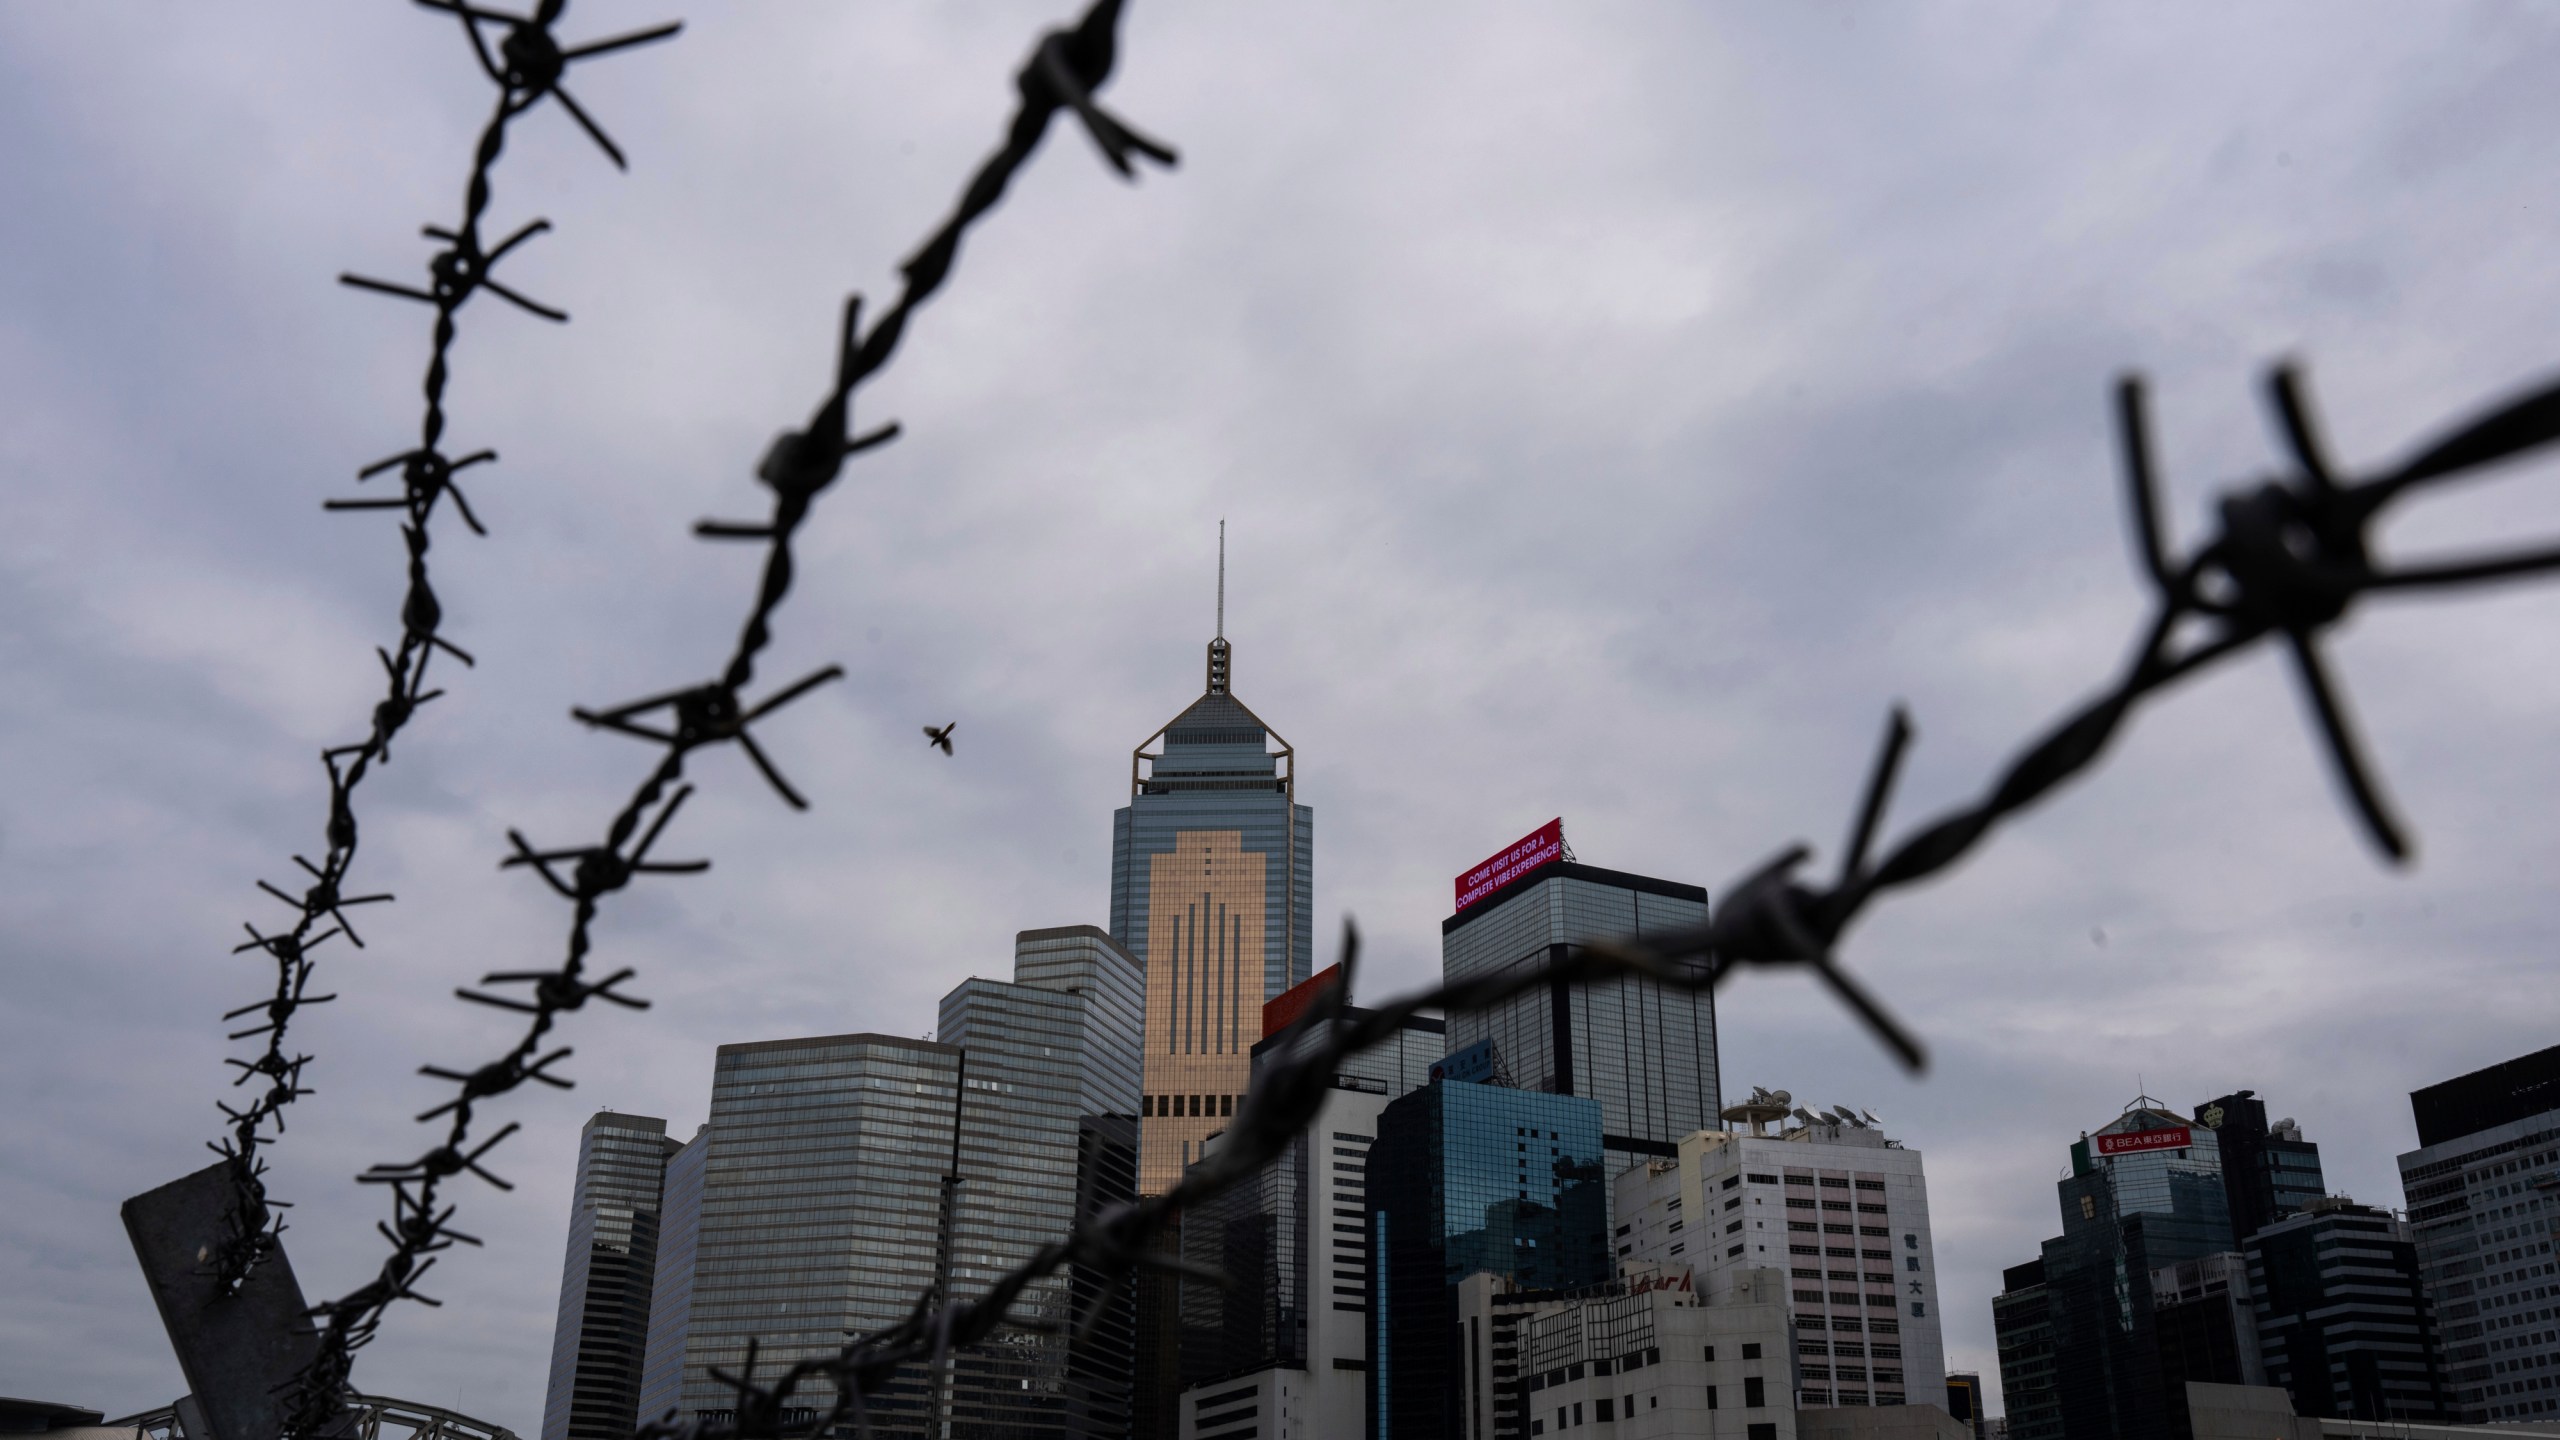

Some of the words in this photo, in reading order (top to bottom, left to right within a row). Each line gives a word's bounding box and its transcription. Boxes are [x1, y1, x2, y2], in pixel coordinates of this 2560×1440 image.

[1456, 880, 1493, 908] COMPLETE
[1494, 869, 1510, 887] VIBE
[1511, 841, 1559, 878] EXPERIENCE!
[1468, 866, 1490, 887] COME
[1491, 855, 1509, 873] VISIT
[1510, 849, 1520, 862] US
[1521, 839, 1537, 856] FOR
[1538, 835, 1545, 847] A
[2116, 1137, 2142, 1148] BEA
[2143, 1132, 2182, 1145] 東亞銀行
